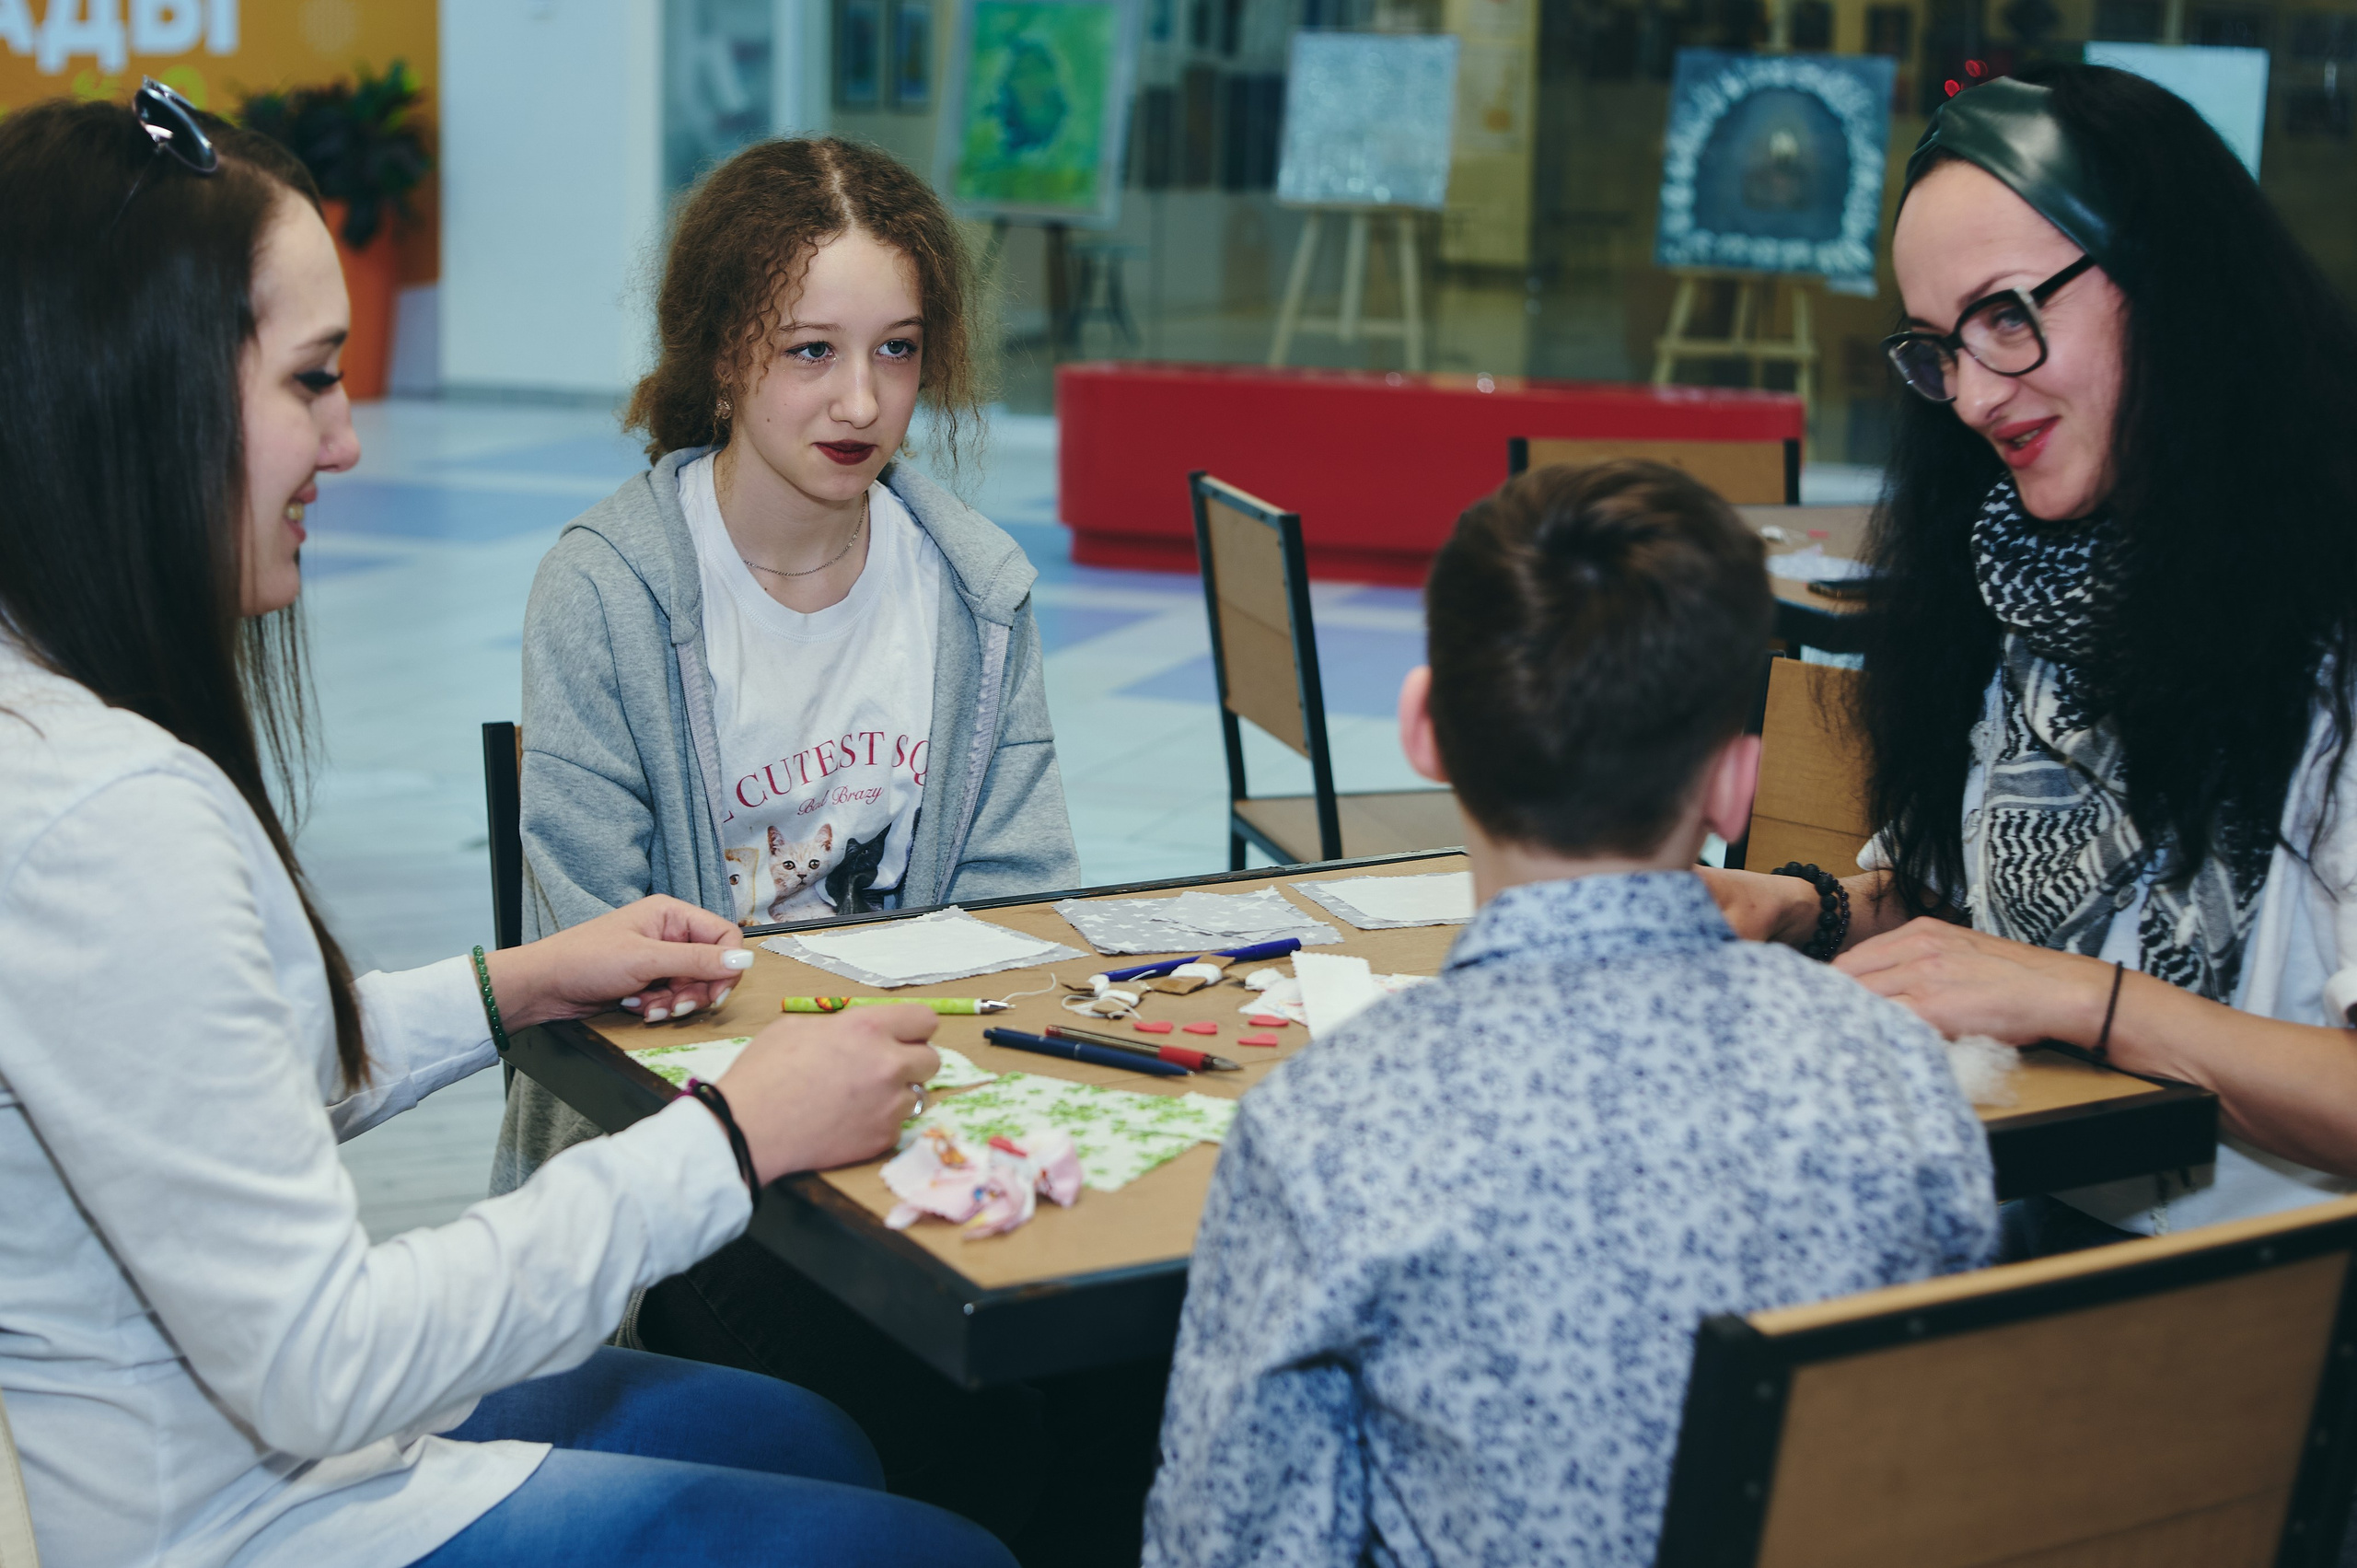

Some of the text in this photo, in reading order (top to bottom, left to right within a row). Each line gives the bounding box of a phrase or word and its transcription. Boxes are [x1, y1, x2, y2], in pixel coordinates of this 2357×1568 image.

[736, 731, 885, 807] CUTEST
[797, 785, 883, 816] Bad Brazy
